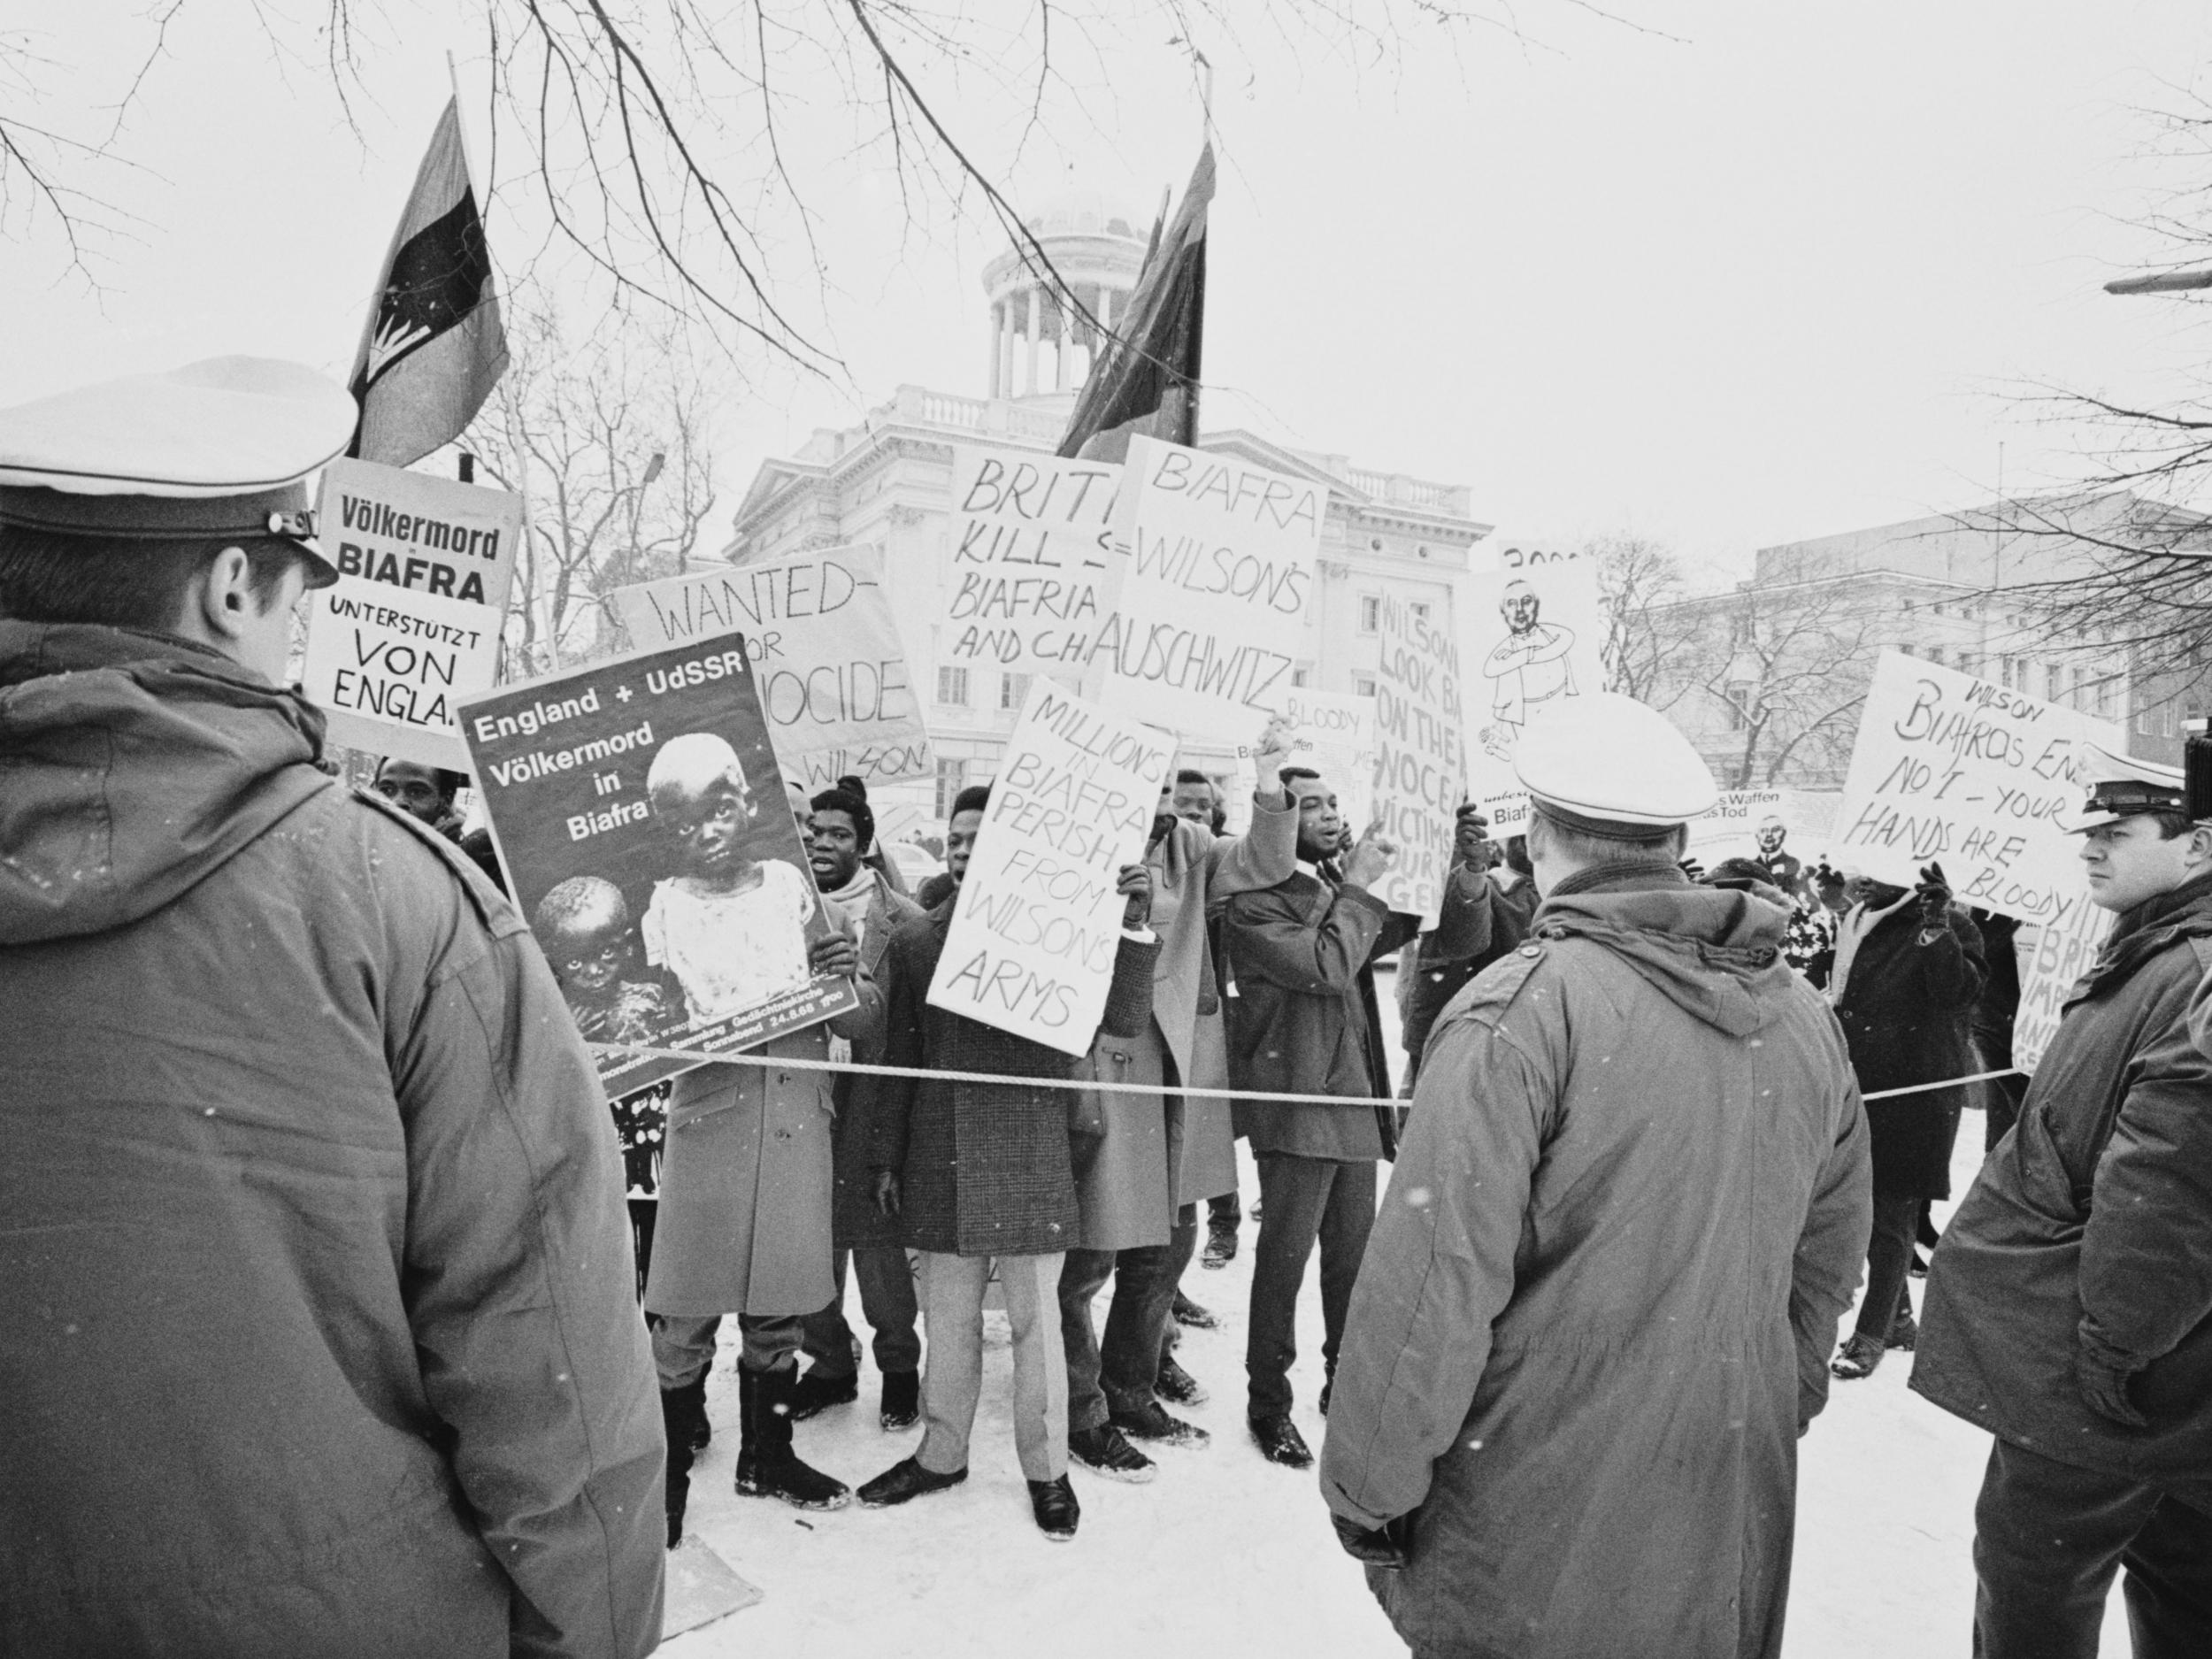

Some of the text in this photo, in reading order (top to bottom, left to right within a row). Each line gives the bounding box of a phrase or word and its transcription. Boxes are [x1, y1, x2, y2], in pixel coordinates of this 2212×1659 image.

[1153, 451, 1317, 538] BIAFRA
[342, 495, 500, 560] Völkermord
[338, 542, 485, 604] BIAFRA
[356, 628, 456, 685] VON
[745, 632, 785, 662] OR
[954, 625, 1088, 664] AND CH
[1087, 611, 1292, 713] AUSCHWITZ
[334, 669, 454, 726] ENGLA
[474, 651, 743, 742] England + UdSSR
[761, 659, 906, 727] OCIDE
[1379, 630, 1463, 721] LOOK BA
[1965, 680, 2045, 722] WILSON
[1032, 694, 1167, 784] MILLIONS
[1287, 697, 1360, 736] BLOODY
[1378, 684, 1455, 766] ON THE
[489, 721, 654, 787] Völkermord
[594, 770, 620, 796] in
[803, 743, 926, 786] WILSON
[1065, 750, 1100, 779] IN
[2032, 739, 2078, 782] EN
[567, 799, 649, 841] Biafra
[1006, 752, 1147, 842] BIAFRA
[1720, 806, 1747, 818] Tod
[1728, 792, 1779, 805] Waffen
[1993, 785, 2068, 832] YOUR
[993, 791, 1119, 872] PERISH
[1843, 801, 1955, 861] HANDS
[1960, 826, 2026, 868] ARE
[1001, 849, 1106, 918] FROM
[1961, 866, 2073, 926] BLOODY
[946, 949, 1079, 1027] ARMS
[670, 1025, 726, 1051] Sammlung
[733, 987, 824, 1027] Gedächtniskirche
[703, 1023, 764, 1052] Sonnabend
